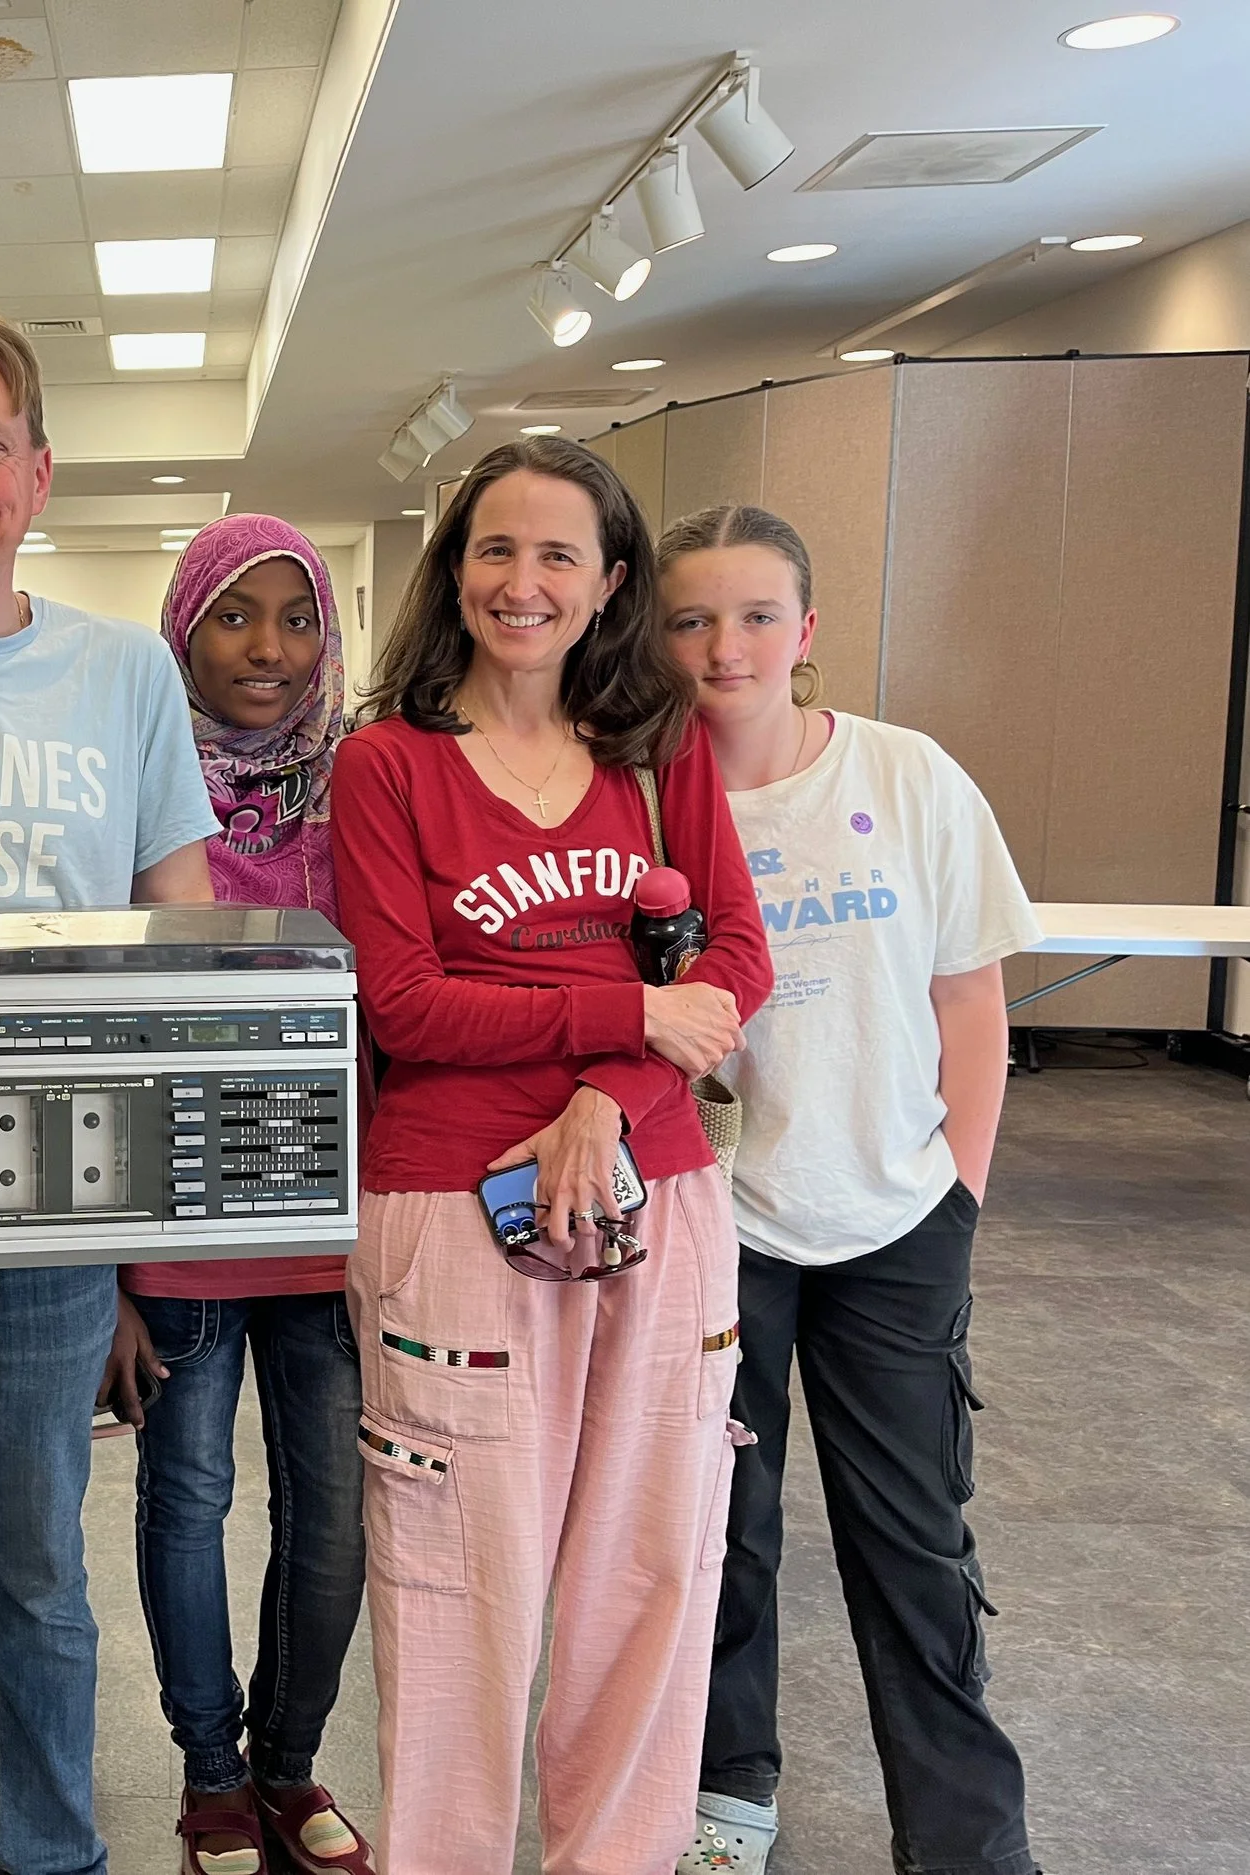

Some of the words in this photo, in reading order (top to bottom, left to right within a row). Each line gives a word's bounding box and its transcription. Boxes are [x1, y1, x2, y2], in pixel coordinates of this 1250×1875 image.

[452, 847, 650, 935] STANFOR
[761, 887, 898, 933] WARD
[510, 917, 632, 952] Cardina
[793, 977, 832, 988] Women
